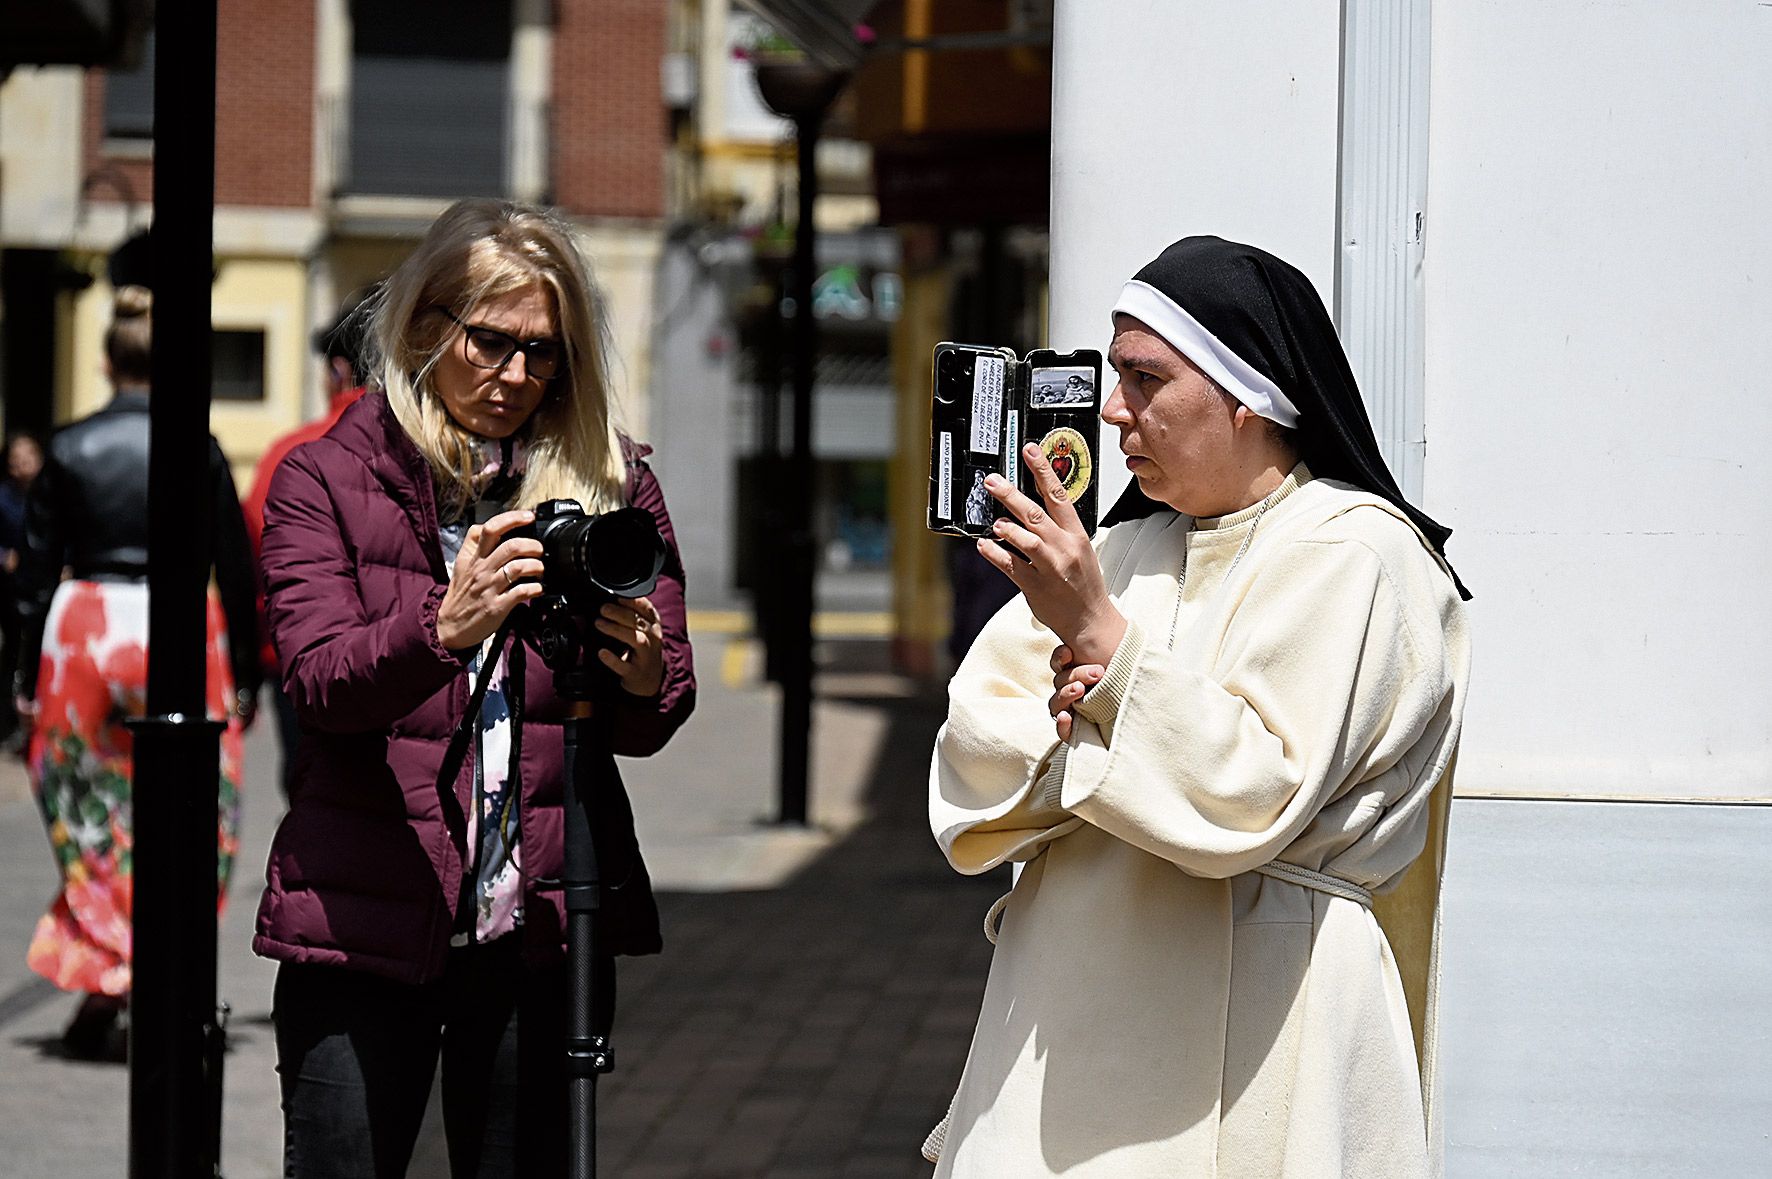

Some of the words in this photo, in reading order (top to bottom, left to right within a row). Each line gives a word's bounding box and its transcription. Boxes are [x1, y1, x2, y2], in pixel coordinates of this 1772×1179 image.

[983, 359, 989, 367] EL
[997, 364, 1003, 374] EN
[981, 385, 987, 395] DE
[988, 385, 994, 395] EN
[981, 395, 986, 404] TU
[987, 394, 993, 403] EL
[986, 424, 992, 432] TE
[993, 425, 999, 434] DE
[979, 430, 985, 440] EN
[979, 439, 984, 448] LA
[944, 457, 950, 467] DE
